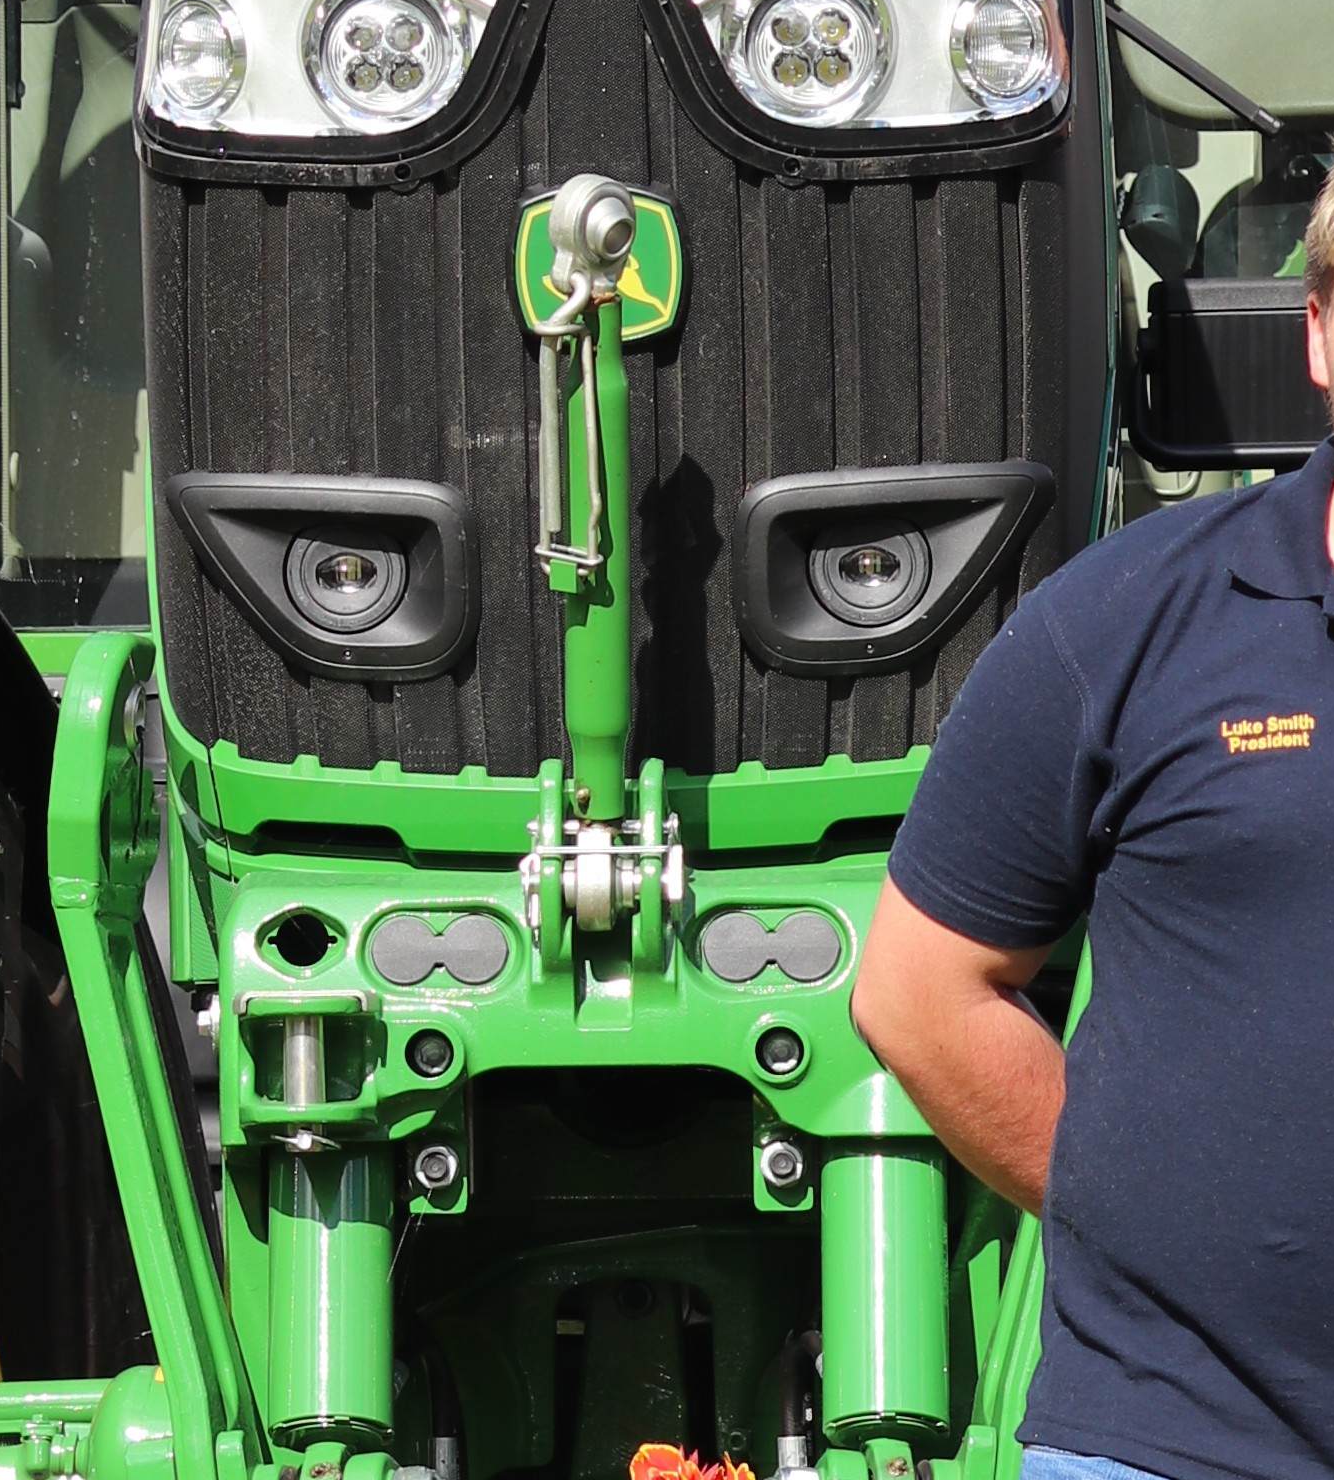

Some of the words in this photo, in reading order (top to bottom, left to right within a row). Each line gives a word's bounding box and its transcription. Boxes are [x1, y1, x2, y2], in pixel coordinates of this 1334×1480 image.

[1221, 719, 1264, 738] Luke
[1266, 713, 1316, 733] Smith
[1229, 731, 1311, 754] President
